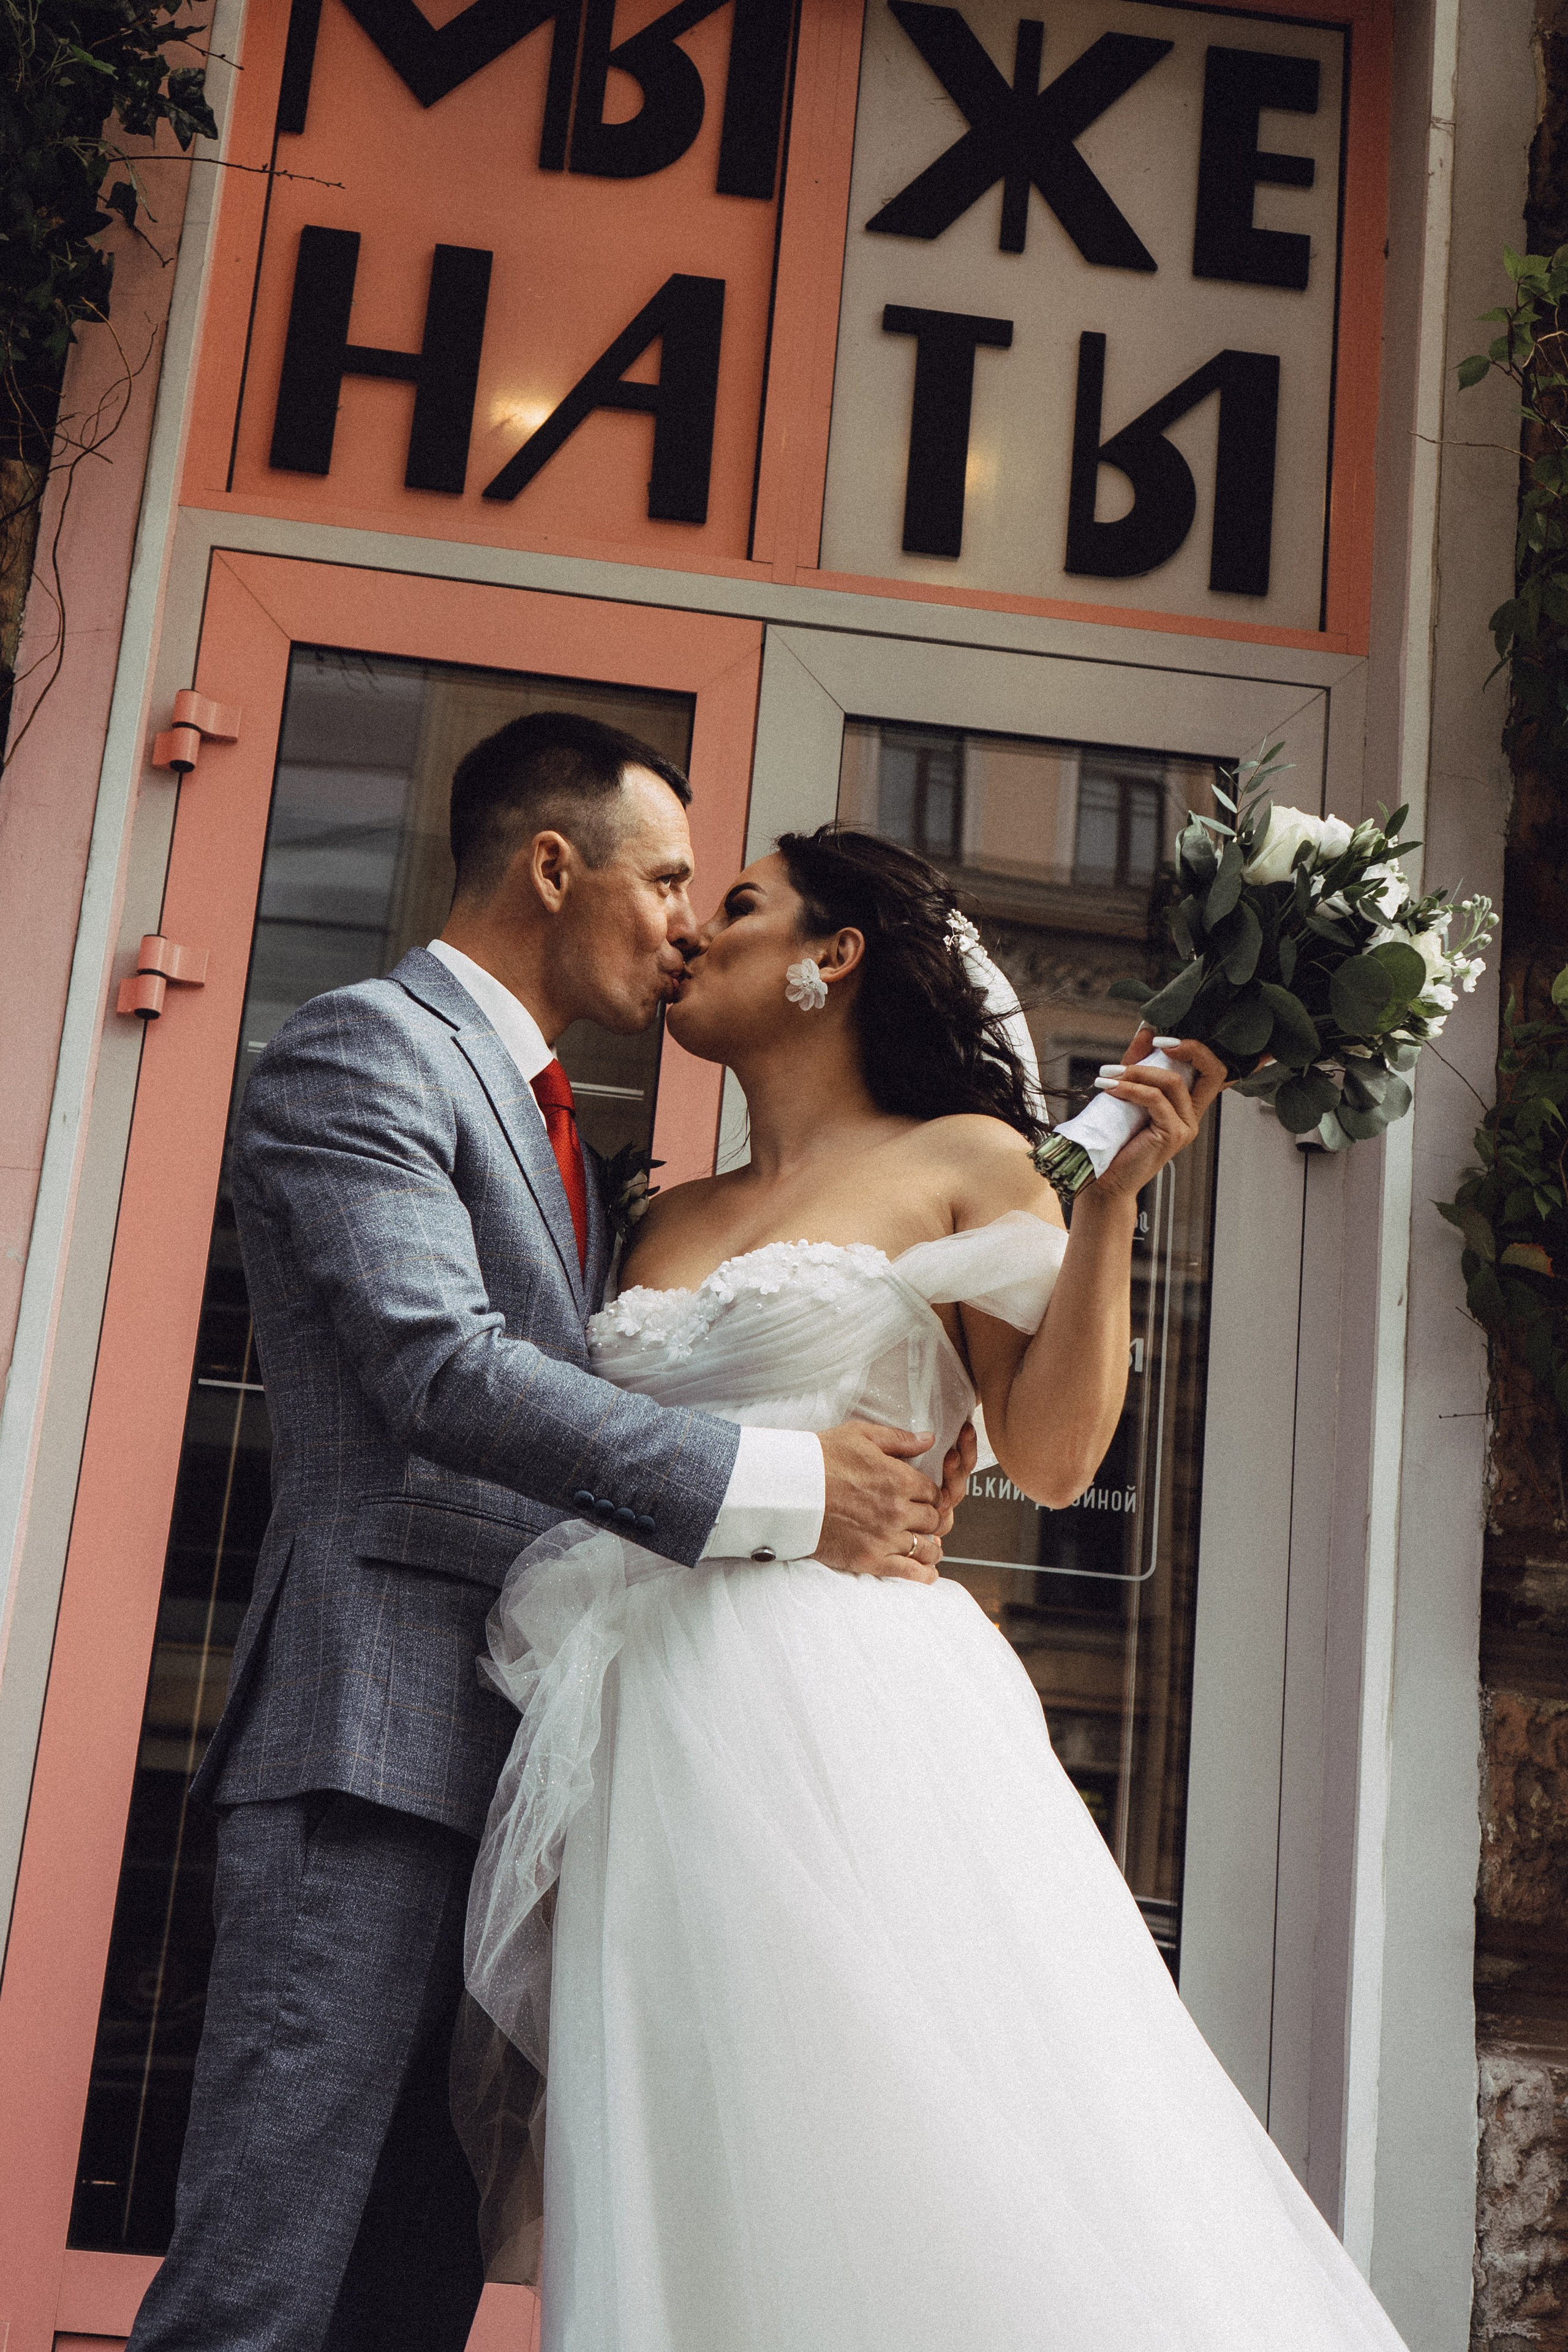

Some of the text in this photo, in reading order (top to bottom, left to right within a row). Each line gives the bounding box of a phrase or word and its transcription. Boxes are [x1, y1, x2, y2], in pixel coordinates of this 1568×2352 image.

[276, 0, 1321, 291] МЫ ЖЕ
[268, 224, 1280, 598] НА ТЫ
